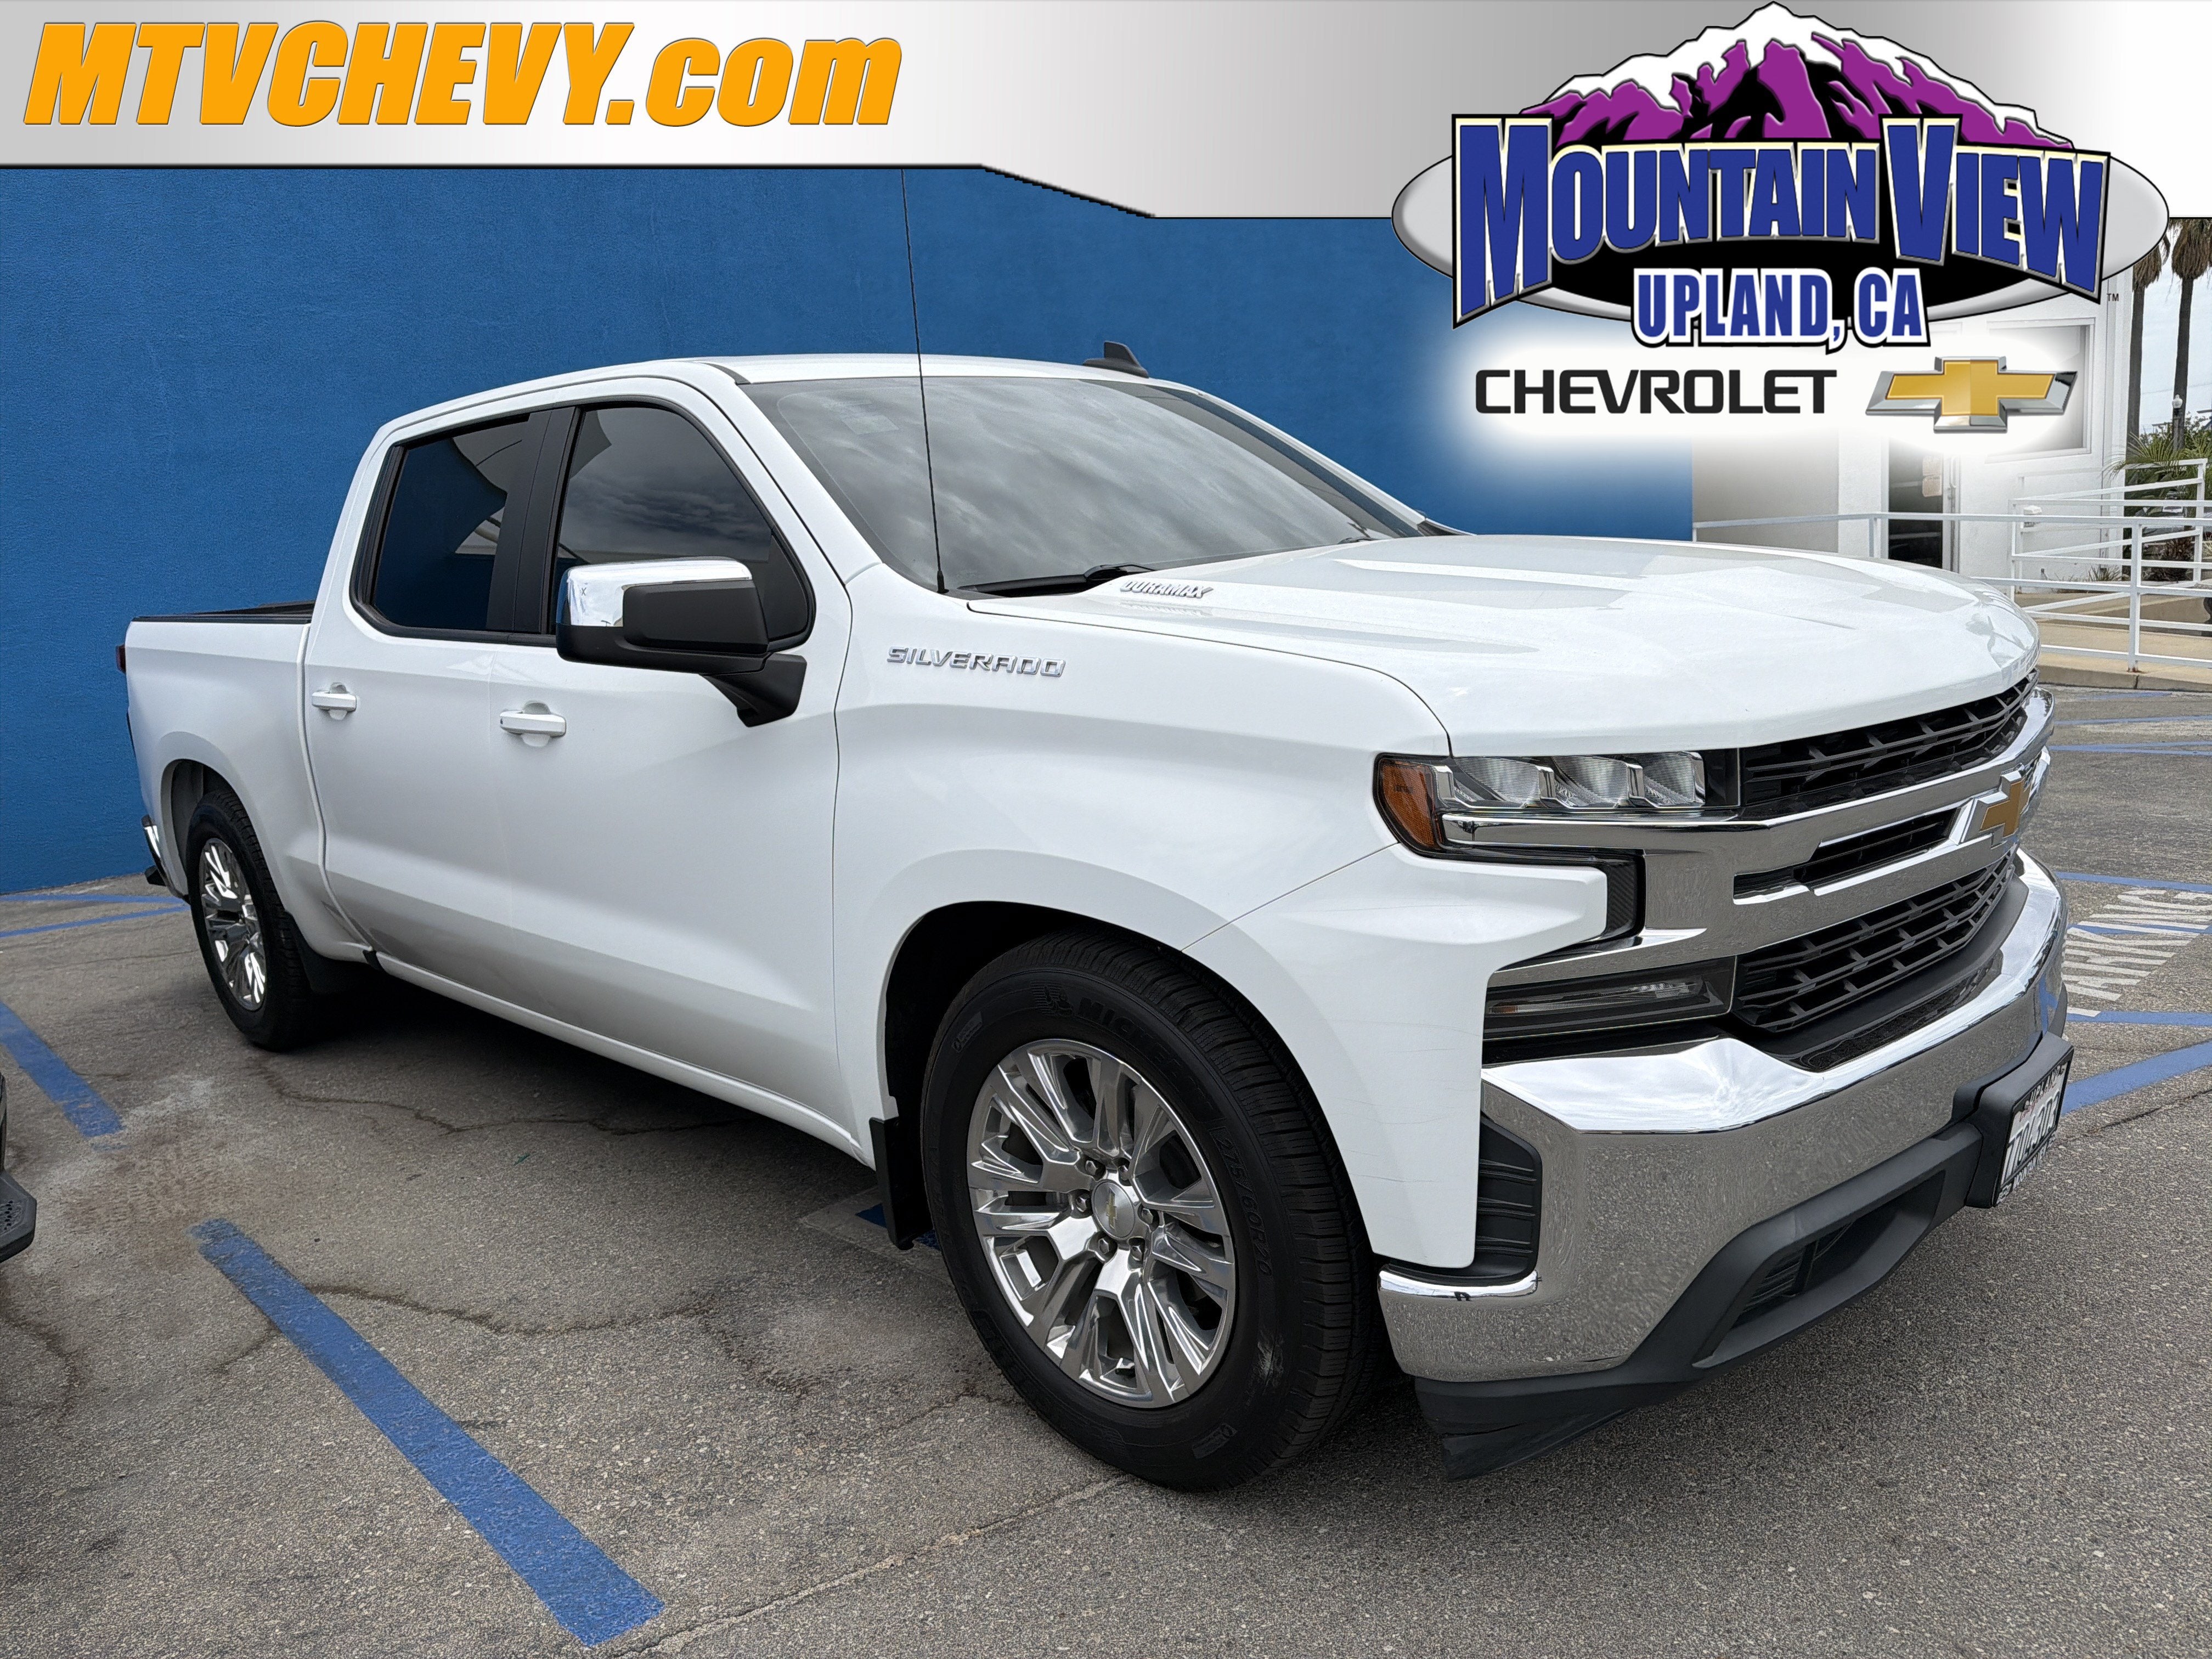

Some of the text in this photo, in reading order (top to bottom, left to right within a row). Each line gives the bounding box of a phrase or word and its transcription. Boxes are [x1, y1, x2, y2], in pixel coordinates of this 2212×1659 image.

[1120, 580, 1214, 599] DURAMAX
[887, 646, 1066, 678] SILVERADO
[2061, 888, 2212, 1018] ARKING
[1219, 1135, 1271, 1276] 275/60R20
